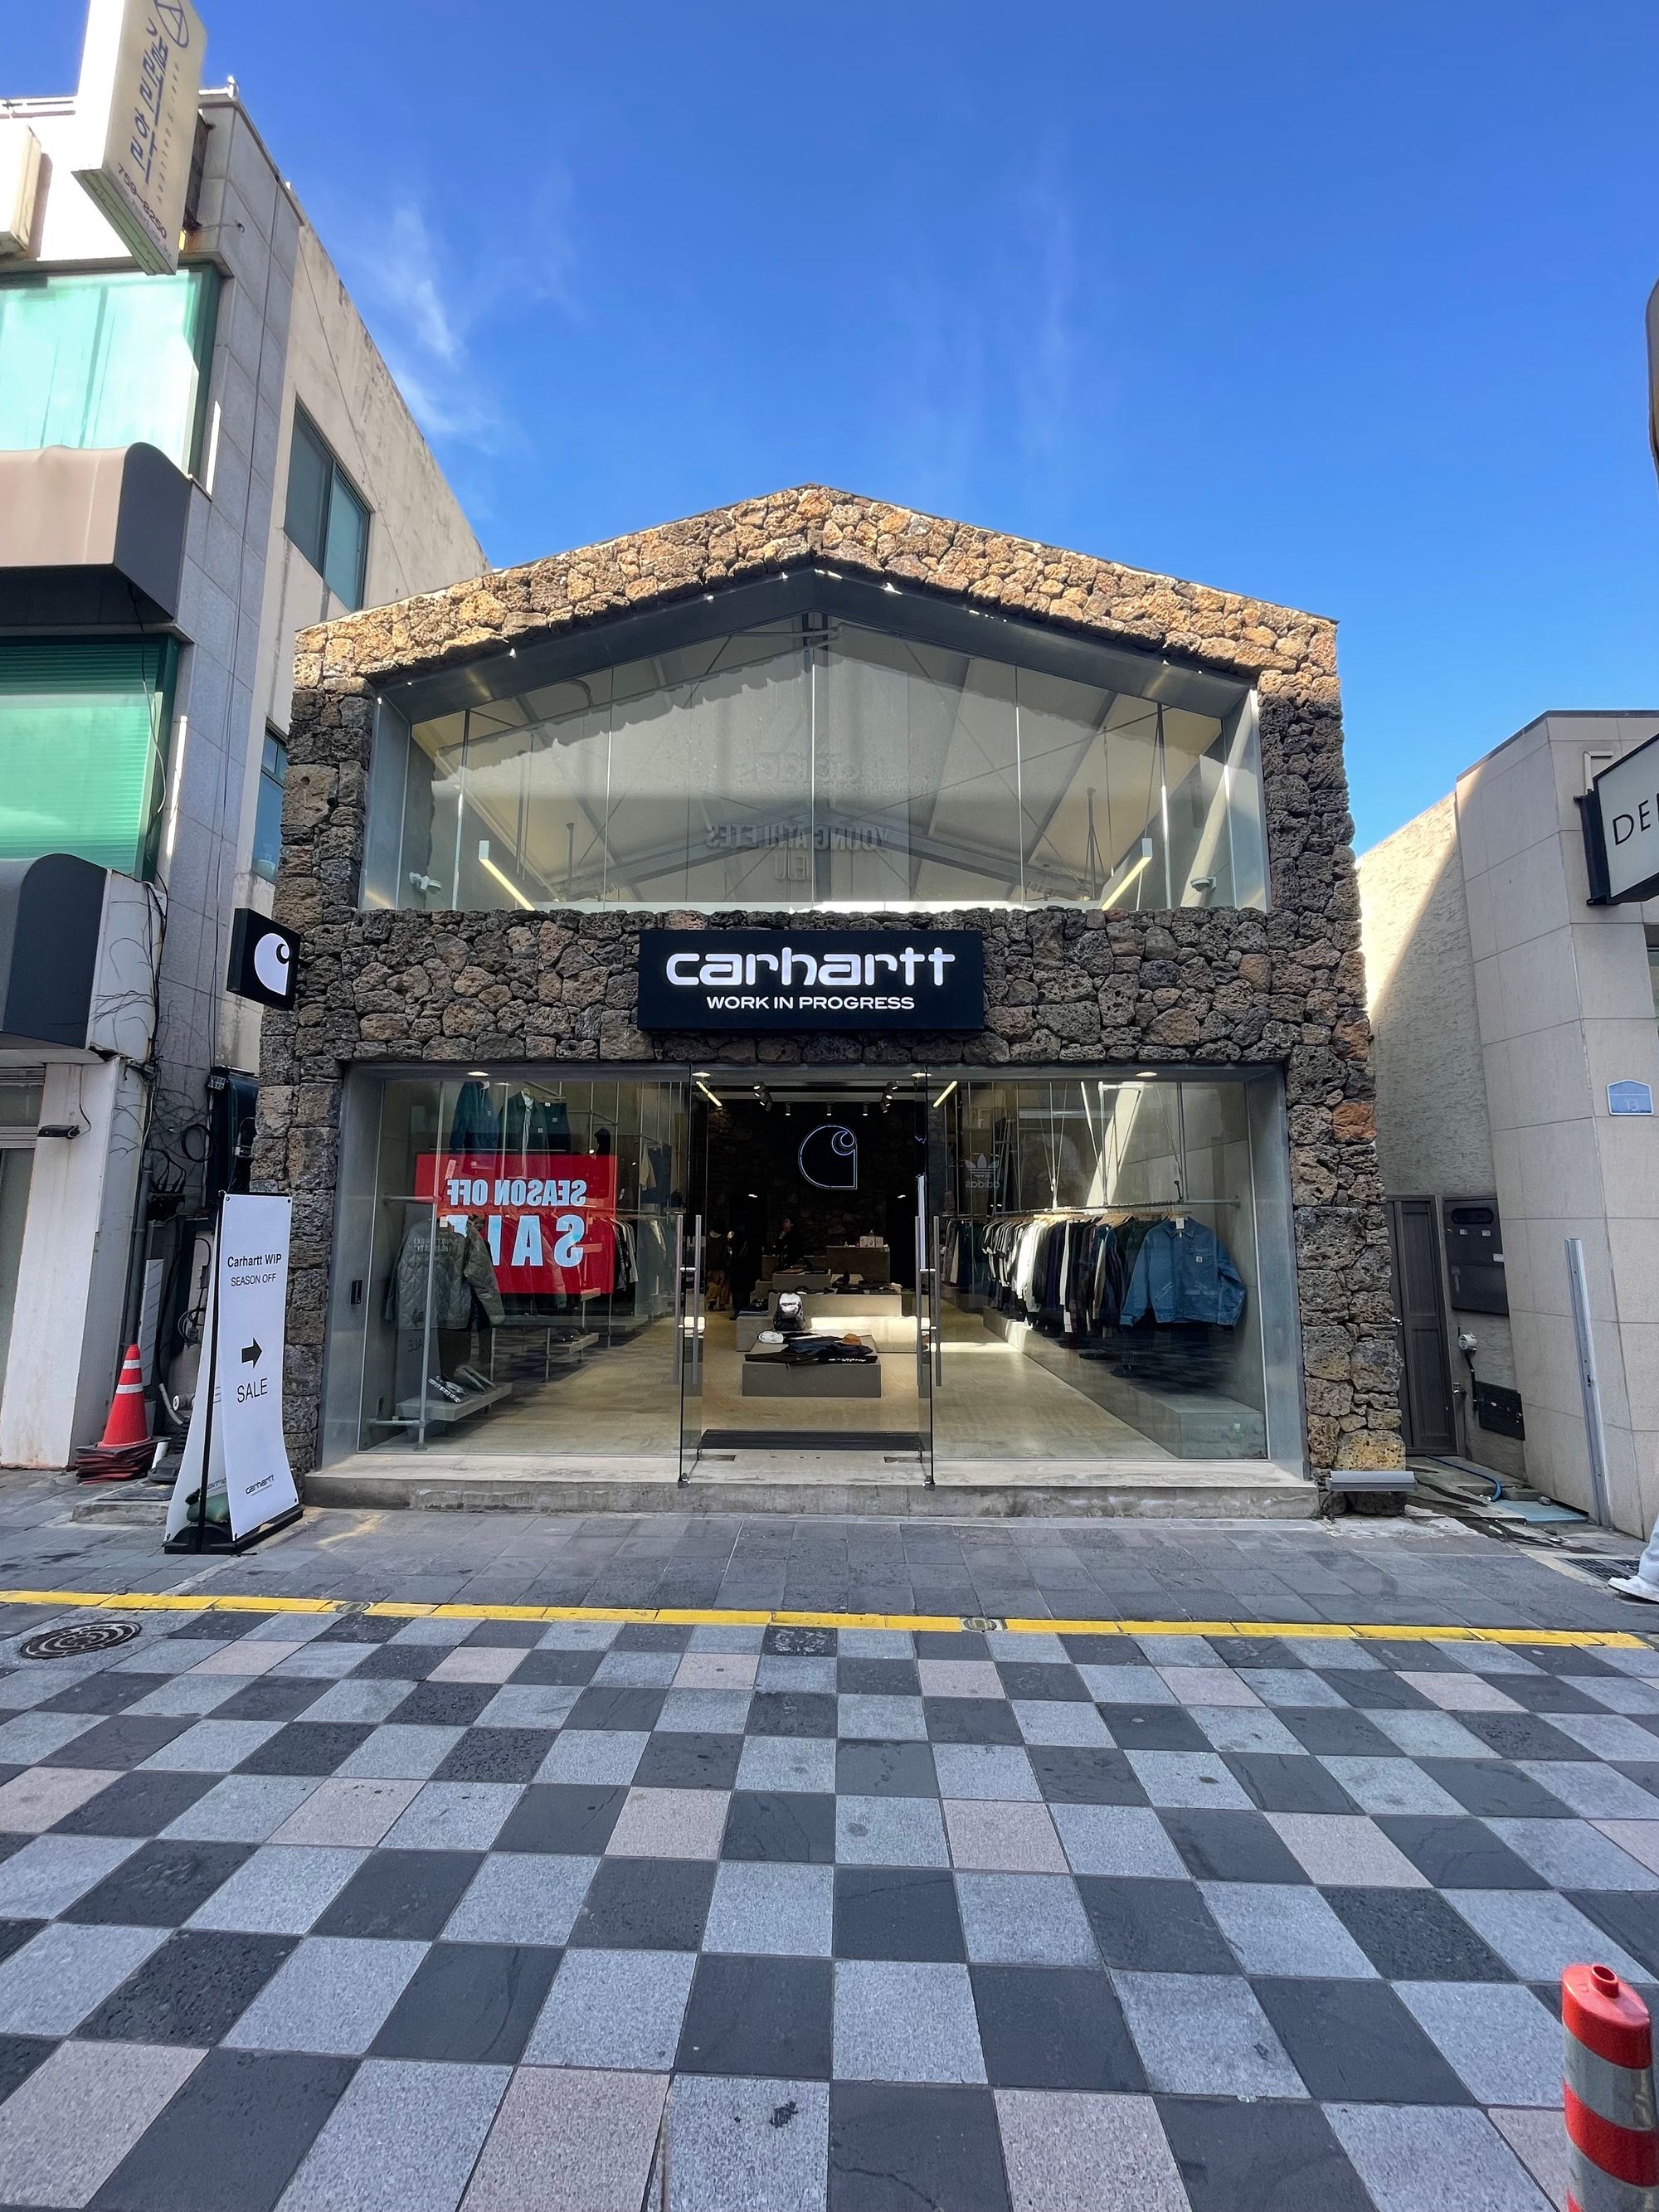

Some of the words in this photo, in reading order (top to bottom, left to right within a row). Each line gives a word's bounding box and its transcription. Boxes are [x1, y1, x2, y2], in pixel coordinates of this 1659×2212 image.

[139, 17, 168, 127] 갤러리
[130, 106, 158, 185] 하리
[1613, 793, 1659, 845] DE
[666, 947, 956, 986] carhartt
[707, 996, 770, 1009] WORK
[774, 996, 793, 1009] IN
[799, 996, 915, 1009] PROGRESS
[227, 1255, 263, 1267] Carhartt
[265, 1253, 282, 1264] WIP
[231, 1275, 261, 1286] SEASON
[262, 1273, 276, 1283] OFF
[237, 1378, 268, 1403] SALE
[245, 1475, 274, 1495] carhartt
